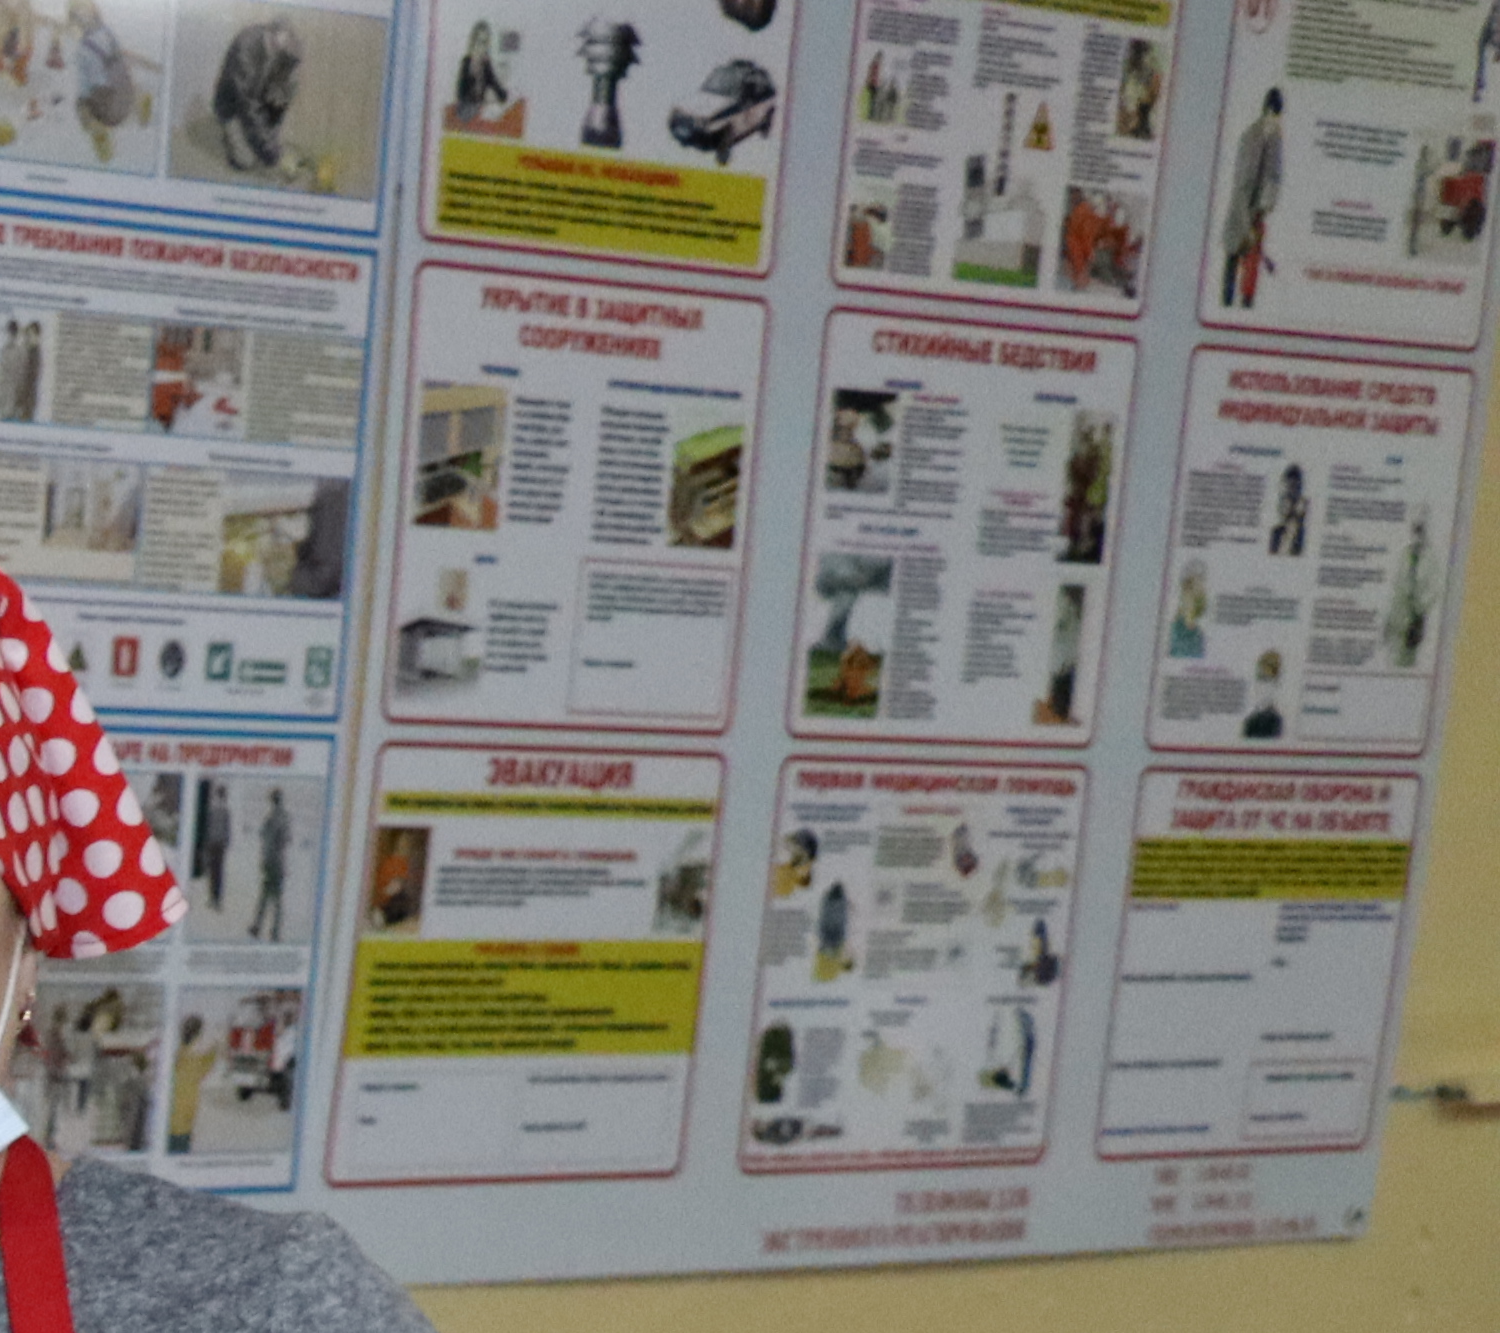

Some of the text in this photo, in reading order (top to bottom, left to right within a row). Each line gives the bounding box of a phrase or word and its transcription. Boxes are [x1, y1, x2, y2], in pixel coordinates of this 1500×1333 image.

[12, 223, 124, 258] ТРЕБОВАНИЯ
[129, 236, 225, 269] ПОЖАРНОЙ
[230, 248, 361, 283] БЕЗОПАСНОСТИ
[872, 329, 1096, 374] СТИХИЙНЫЕ БЕДСТВИЯ
[488, 757, 635, 791] ЭВАКУАЦИЯ
